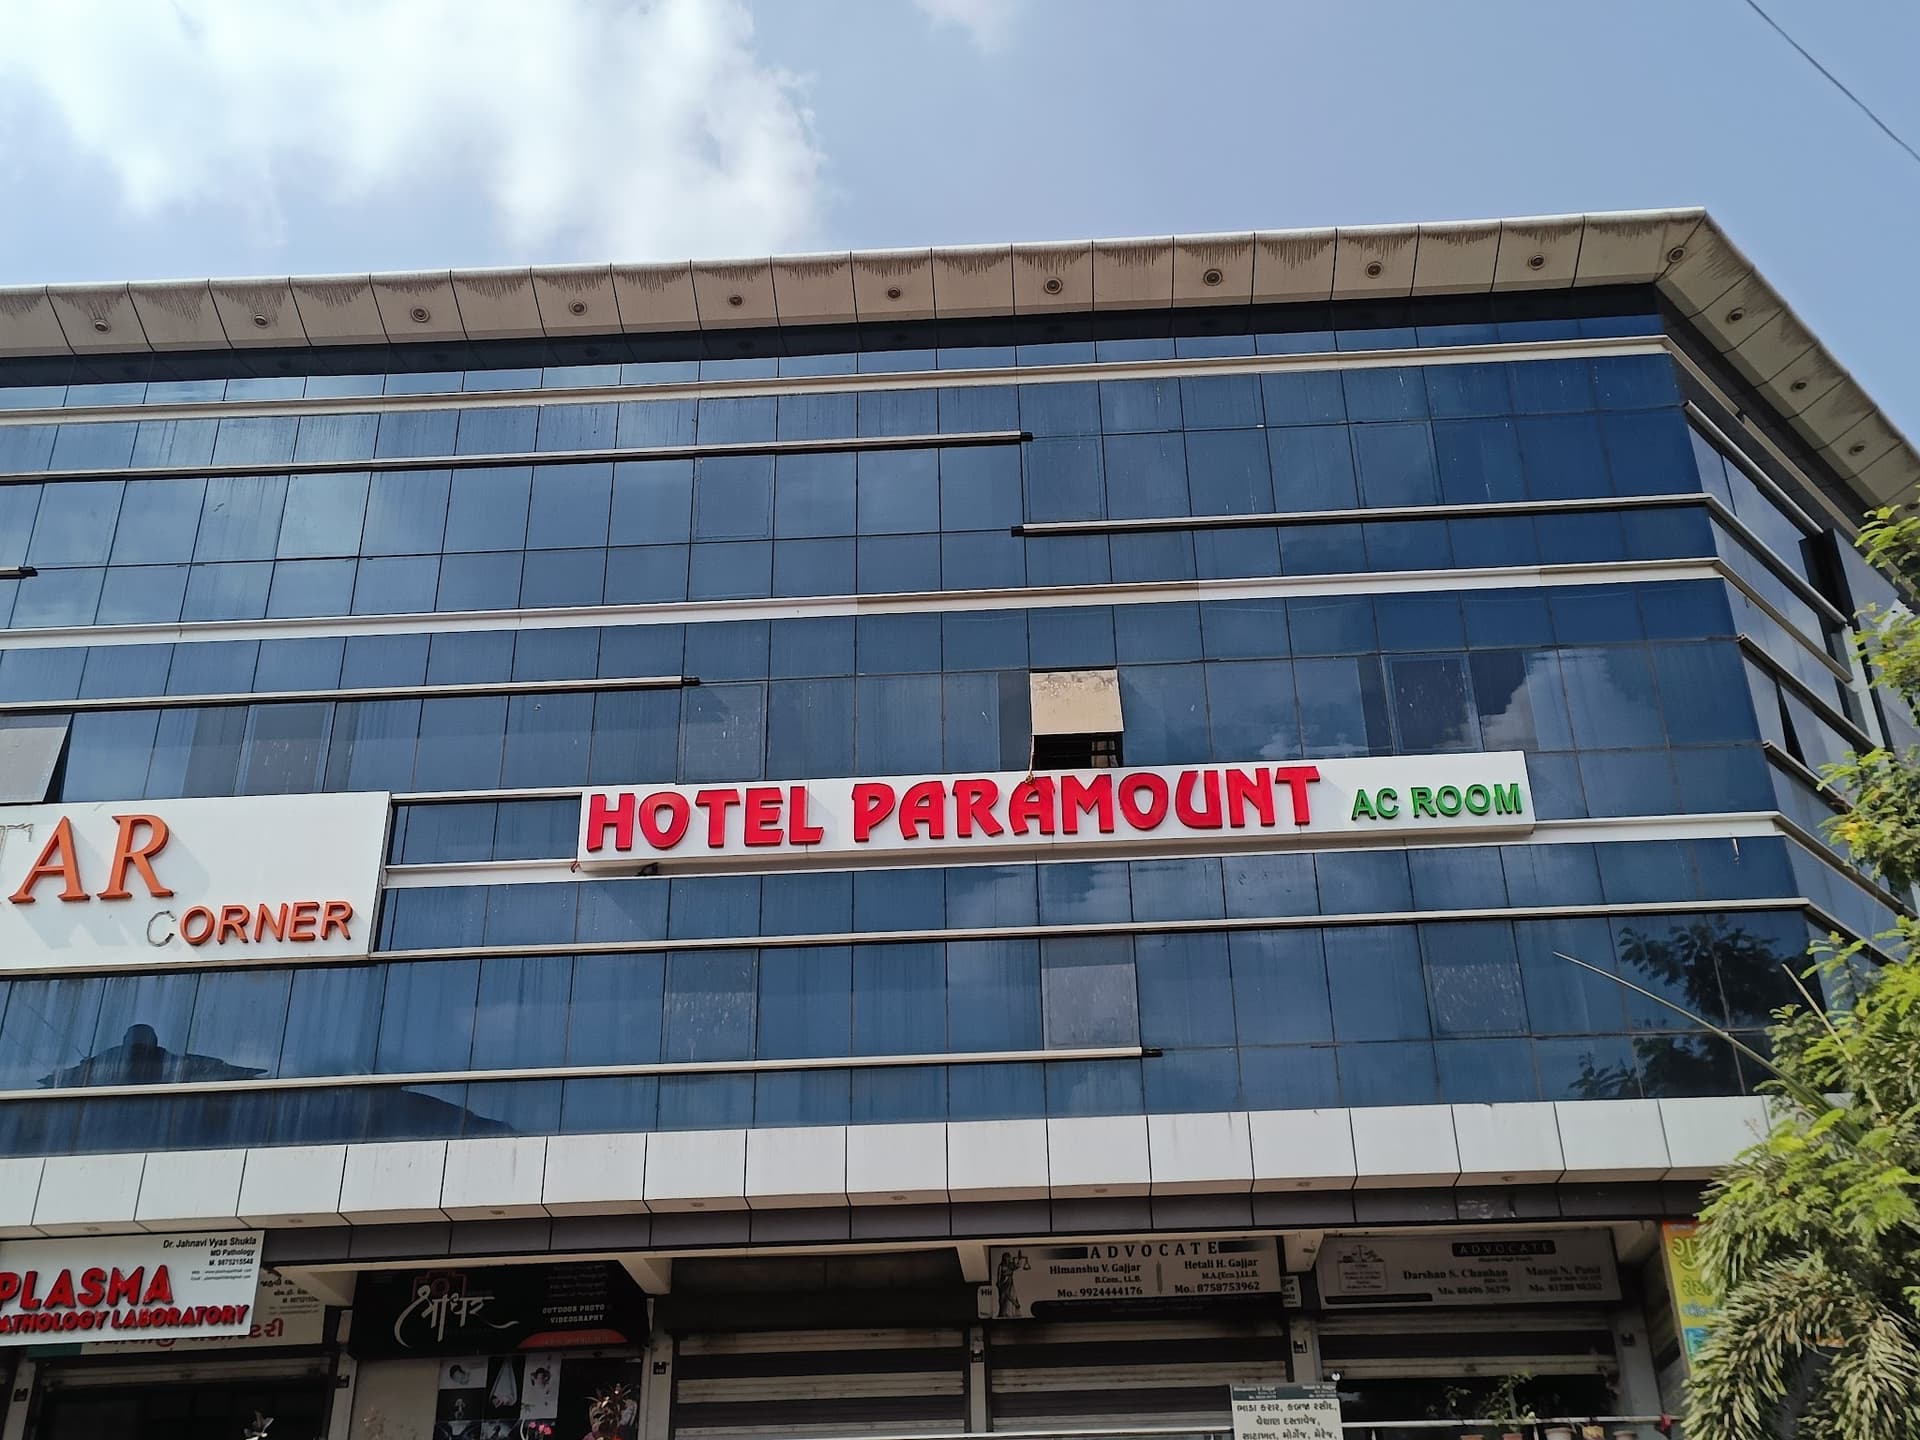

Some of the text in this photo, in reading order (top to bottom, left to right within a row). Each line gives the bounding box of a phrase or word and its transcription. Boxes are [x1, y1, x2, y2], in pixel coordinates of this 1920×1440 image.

[586, 765, 1523, 853] HOTEL PARAMOUNT AC ROOM
[0, 813, 175, 903] AR
[146, 901, 354, 947] CORNER
[163, 1237, 257, 1249] Dr. Jahnavi Vyas Shukla
[1090, 1240, 1219, 1259] ADVOCATE
[1459, 1242, 1551, 1254] ADVOCATE
[1049, 1262, 1141, 1275] Himanshu V. Gajjar
[1184, 1257, 1258, 1270] Hetali H. Gajjar
[1403, 1270, 1446, 1280] Darshan
[0, 1265, 174, 1311] PLASMA
[1080, 1286, 1143, 1297] 9924444176
[1197, 1281, 1259, 1292] 8758753962
[542, 1303, 605, 1314] OUTDOOR PHOTO
[0, 1310, 110, 1334] ATHOLOGY
[111, 1304, 250, 1328] LABORATORY
[550, 1314, 604, 1324] VIDEOGRAPHY
